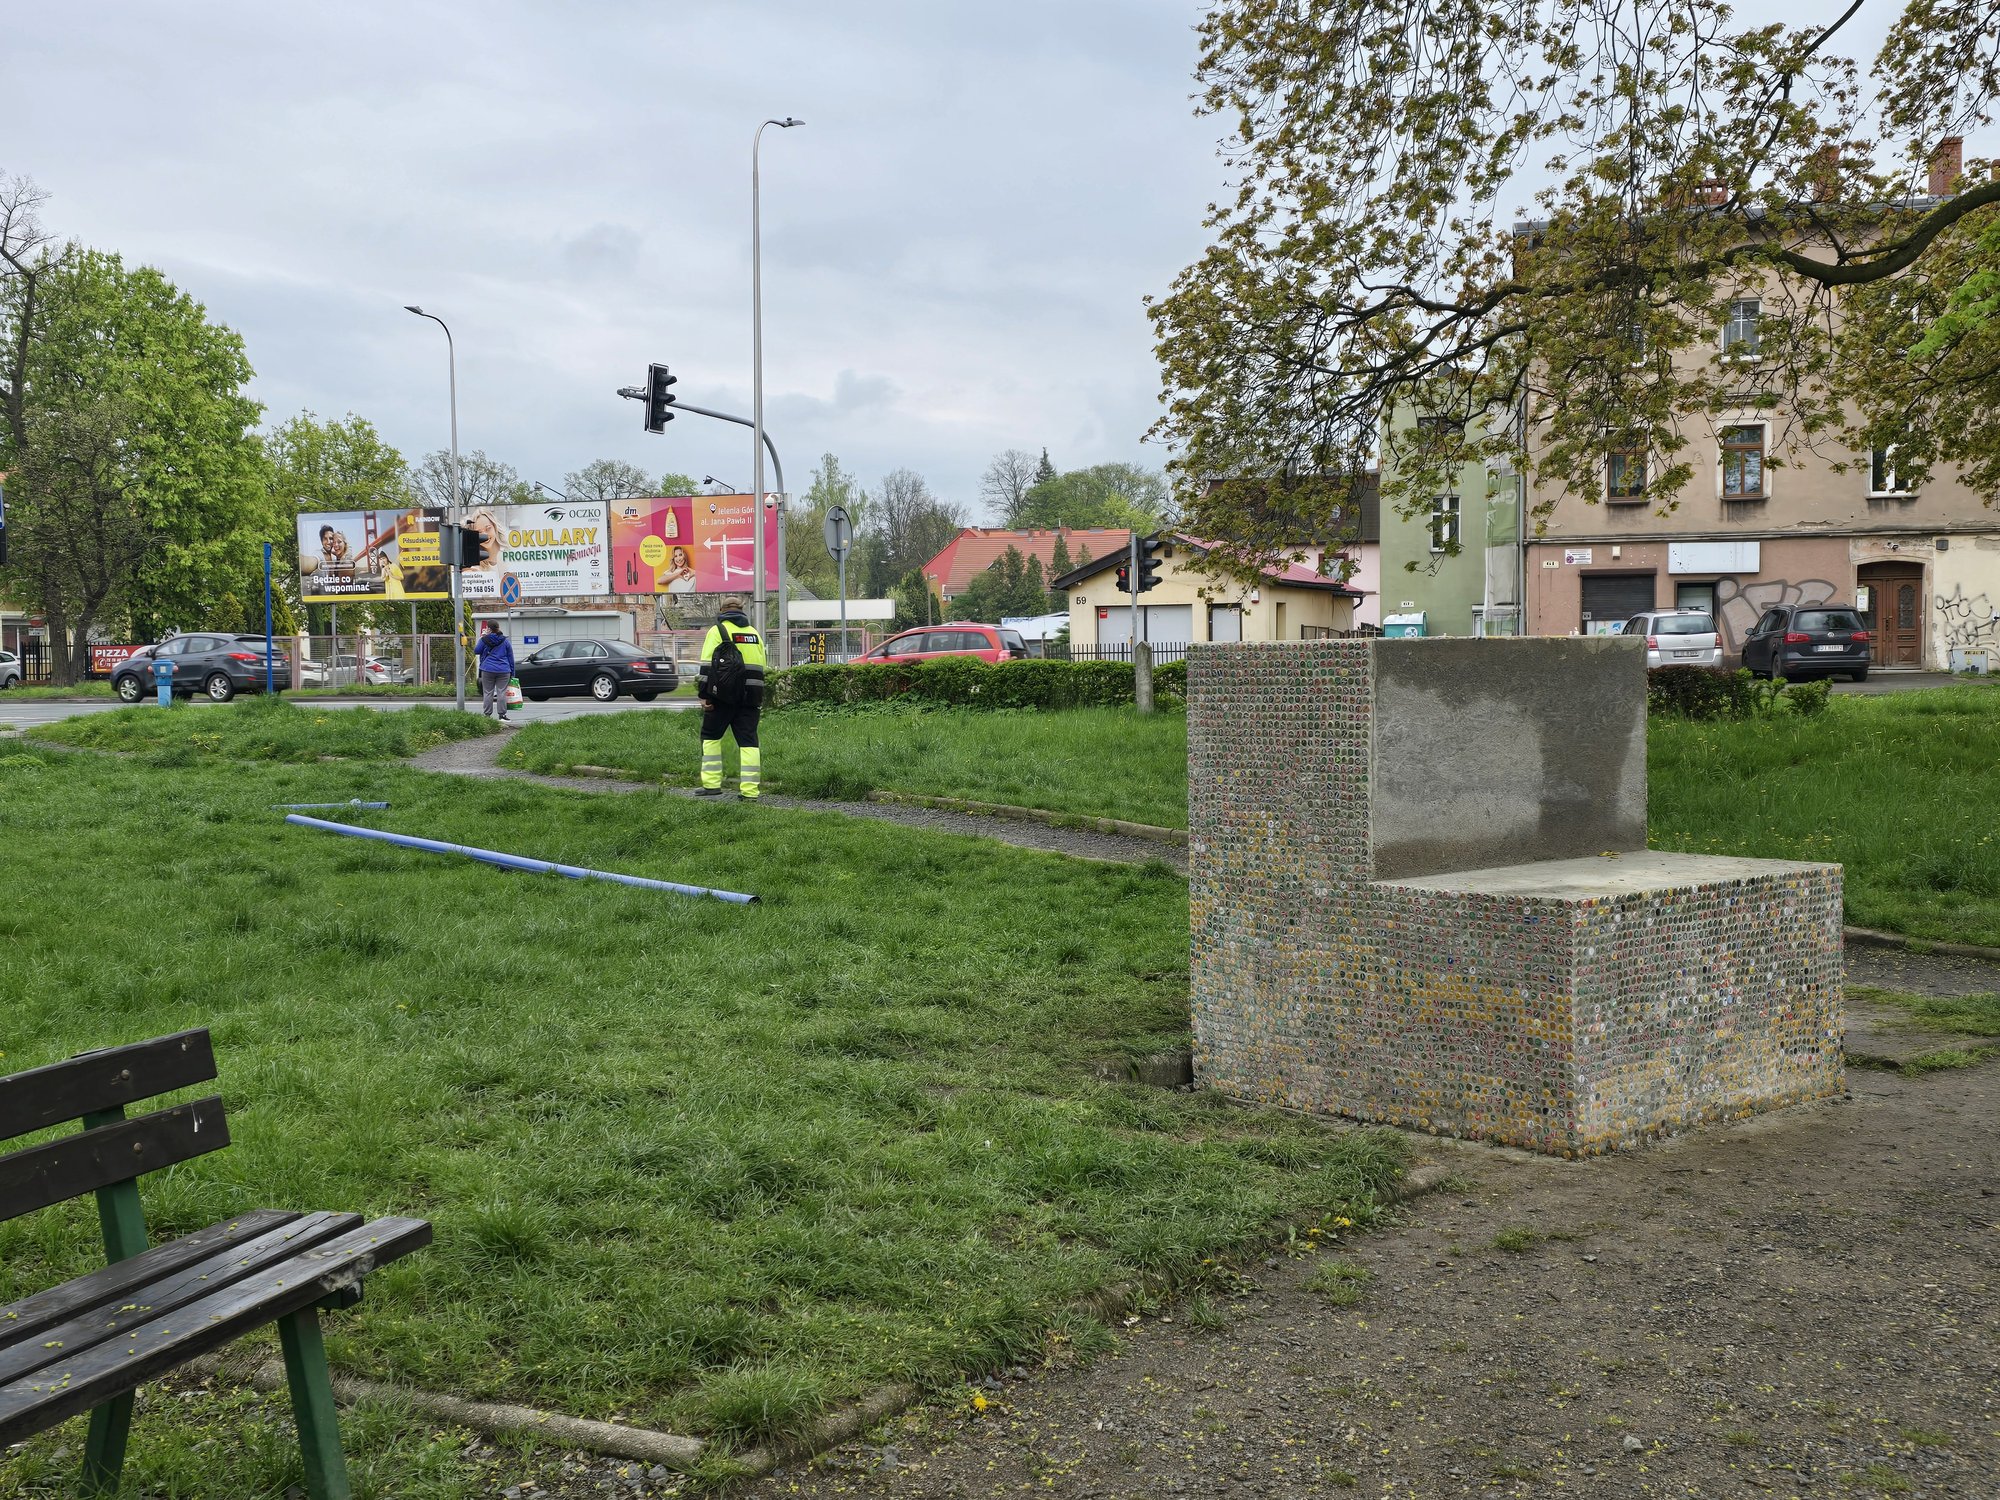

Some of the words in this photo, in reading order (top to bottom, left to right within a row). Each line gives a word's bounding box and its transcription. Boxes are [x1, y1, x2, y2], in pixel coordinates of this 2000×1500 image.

[569, 509, 601, 518] OCZKO
[624, 506, 637, 515] dm
[718, 507, 739, 515] Jelenia
[741, 506, 755, 514] Gór
[727, 516, 746, 525] Pawła
[508, 527, 598, 548] OKULARY
[502, 549, 576, 562] PROGRESYWNE
[535, 570, 579, 578] OPTOMETRYSTA
[313, 574, 340, 585] Będzie
[341, 576, 351, 584] co
[324, 582, 370, 594] wspominać
[1076, 596, 1087, 605] 59
[809, 636, 817, 661] AUT
[95, 649, 129, 658] PIZZA
